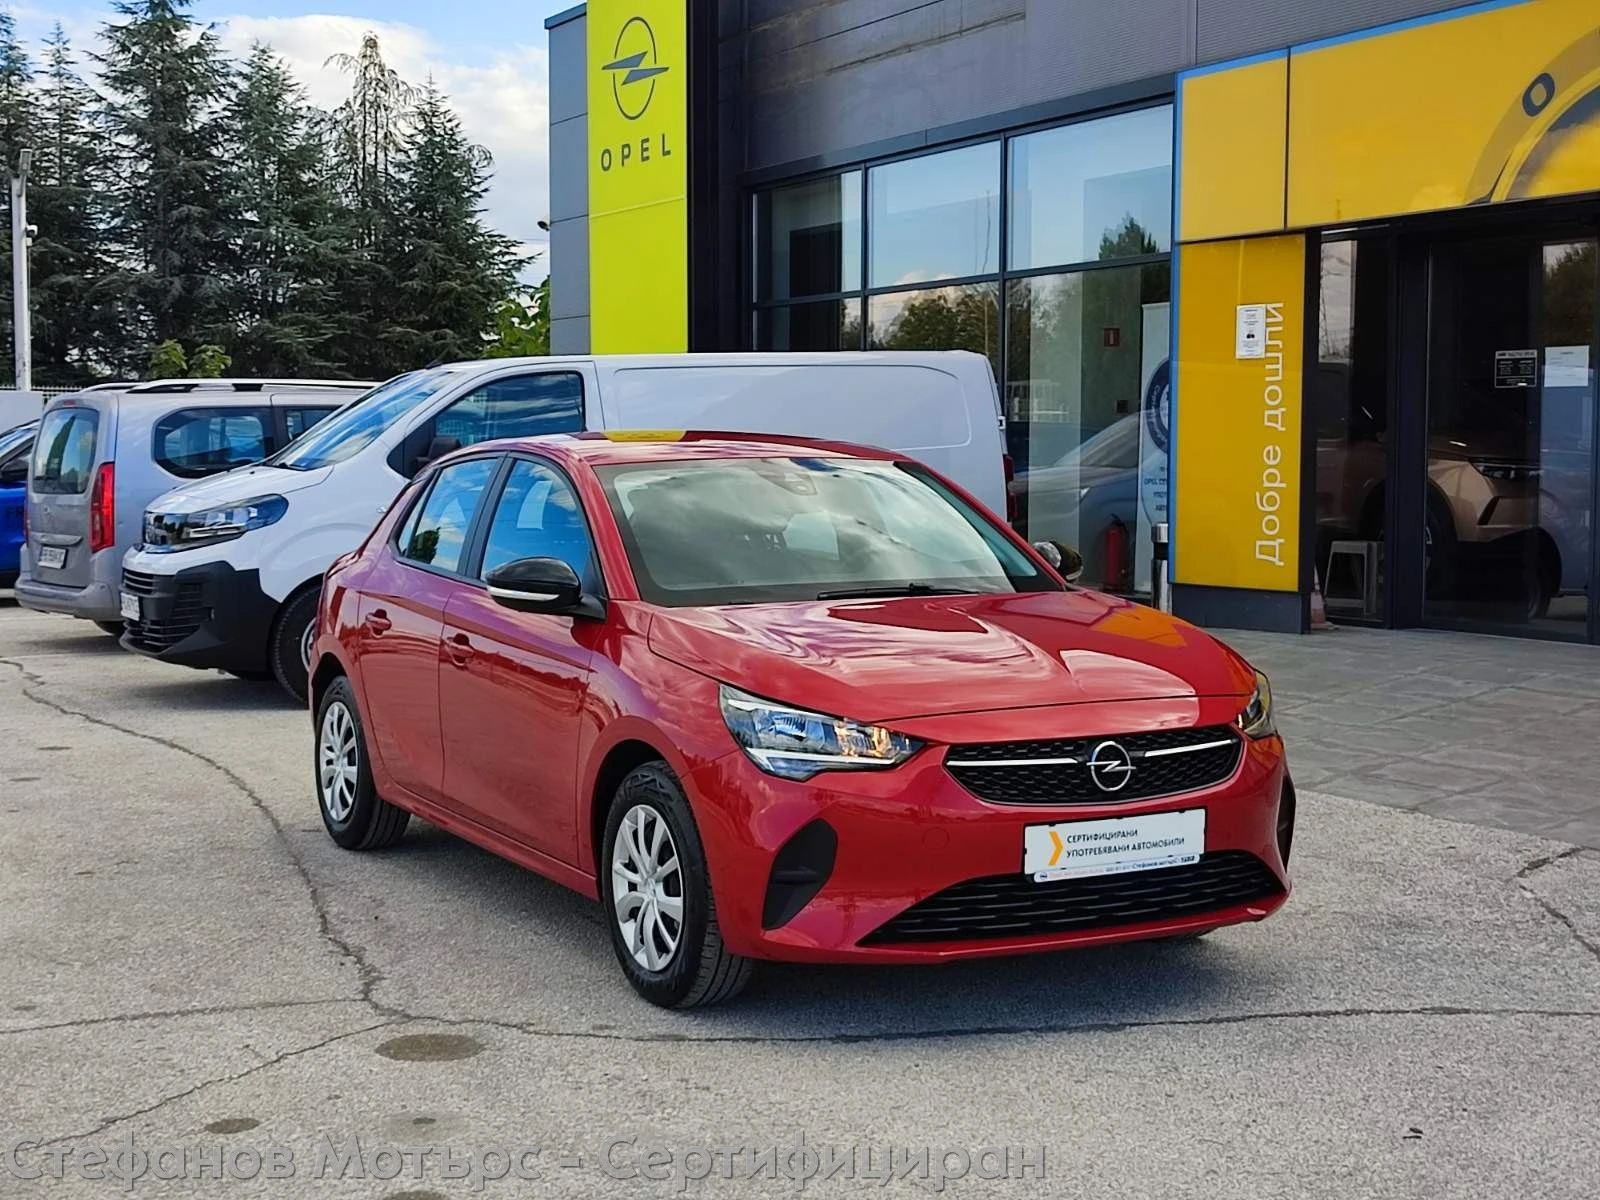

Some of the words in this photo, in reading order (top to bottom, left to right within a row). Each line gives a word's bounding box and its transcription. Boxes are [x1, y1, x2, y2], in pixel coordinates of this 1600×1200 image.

[601, 132, 671, 172] OPEL
[1264, 303, 1286, 431] дошли
[1255, 445, 1286, 566] Добре
[1066, 844, 1130, 858] УПОТРЕБЯВАНИ
[1131, 837, 1185, 851] АВТОМОБИЛИ
[1067, 829, 1138, 843] СЕРТИФИЦИРАНИ
